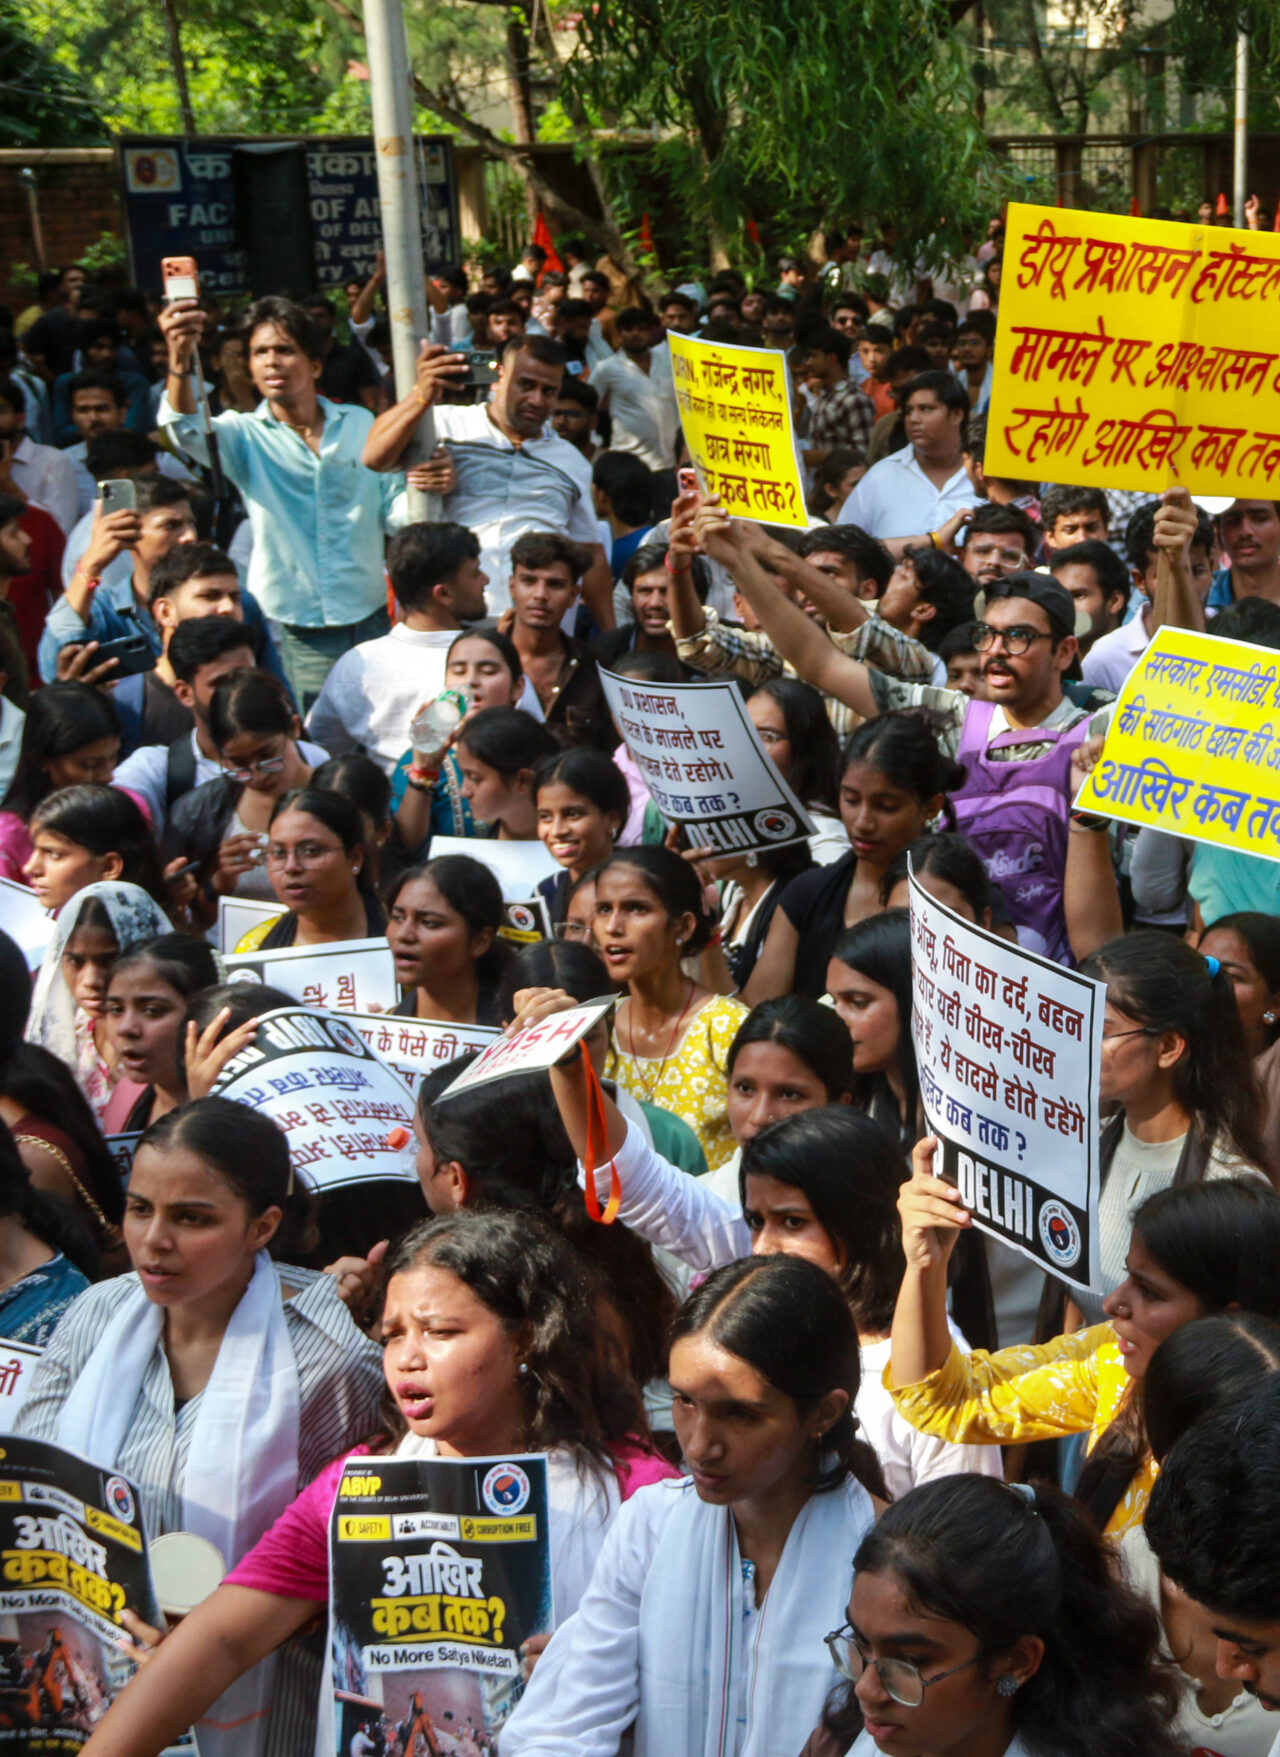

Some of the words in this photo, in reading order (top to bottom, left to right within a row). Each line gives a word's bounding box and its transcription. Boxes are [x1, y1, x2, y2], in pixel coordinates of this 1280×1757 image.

[311, 200, 344, 219] OF
[320, 223, 343, 237] OF
[1017, 219, 1081, 301] डीयू
[1074, 238, 1202, 300] प्रशासन
[1010, 316, 1115, 388] मामले
[1111, 338, 1152, 387] पर
[742, 367, 783, 402] नगर,
[704, 434, 731, 463] छात्र
[732, 431, 772, 471] मरेगा
[1004, 397, 1090, 464] रहोगे
[1082, 409, 1192, 478] आखिर
[1190, 425, 1247, 478] कब
[718, 474, 751, 507] कब
[752, 481, 798, 519] तक?
[1145, 651, 1208, 694] सरकार,
[1205, 662, 1276, 709] एमसीडी,
[653, 724, 698, 750] मामले
[698, 729, 725, 749] पर
[1118, 694, 1147, 736] की
[1142, 703, 1211, 751] सांठगांठ
[1206, 722, 1248, 762] छात्र
[1243, 722, 1274, 768] की
[661, 755, 682, 782] देते
[670, 794, 694, 814] कब
[694, 795, 726, 814] तक
[1092, 757, 1194, 820] आखिर
[1193, 783, 1252, 833] कब
[683, 817, 759, 852] DELHI
[942, 933, 972, 986] पिता
[974, 961, 998, 1001] का
[1001, 974, 1033, 1022] दर्द,
[1037, 991, 1085, 1043] बहन
[376, 1025, 395, 1053] के
[398, 1027, 428, 1058] पैसे
[432, 1033, 459, 1061] की
[473, 1016, 587, 1070] YASH
[936, 990, 962, 1030] यही
[963, 1002, 1056, 1080] चीख-चीख
[267, 1071, 315, 1096] कब
[940, 1034, 952, 1073] ये
[954, 1050, 1000, 1102] हादसे
[1002, 1073, 1039, 1121] होते
[1043, 1094, 1086, 1145] रहेंगे
[304, 1102, 335, 1127] से
[945, 1095, 973, 1136] कब
[976, 1112, 1011, 1152] तक
[957, 1151, 1034, 1243] DELHI
[340, 1476, 382, 1497] ABVP
[13, 1513, 109, 1580] आखिर
[358, 1522, 384, 1534] SAFETY
[476, 1523, 514, 1534] CORRUPTION
[515, 1521, 532, 1533] FREE
[1, 1550, 70, 1583] कब
[68, 1560, 127, 1625] तक?
[381, 1541, 485, 1598] आखिर
[370, 1595, 442, 1637] कब
[442, 1595, 507, 1644] तक?
[370, 1649, 391, 1665] No
[394, 1648, 434, 1664] More
[438, 1647, 471, 1667] Satya
[471, 1649, 512, 1668] Niketan
